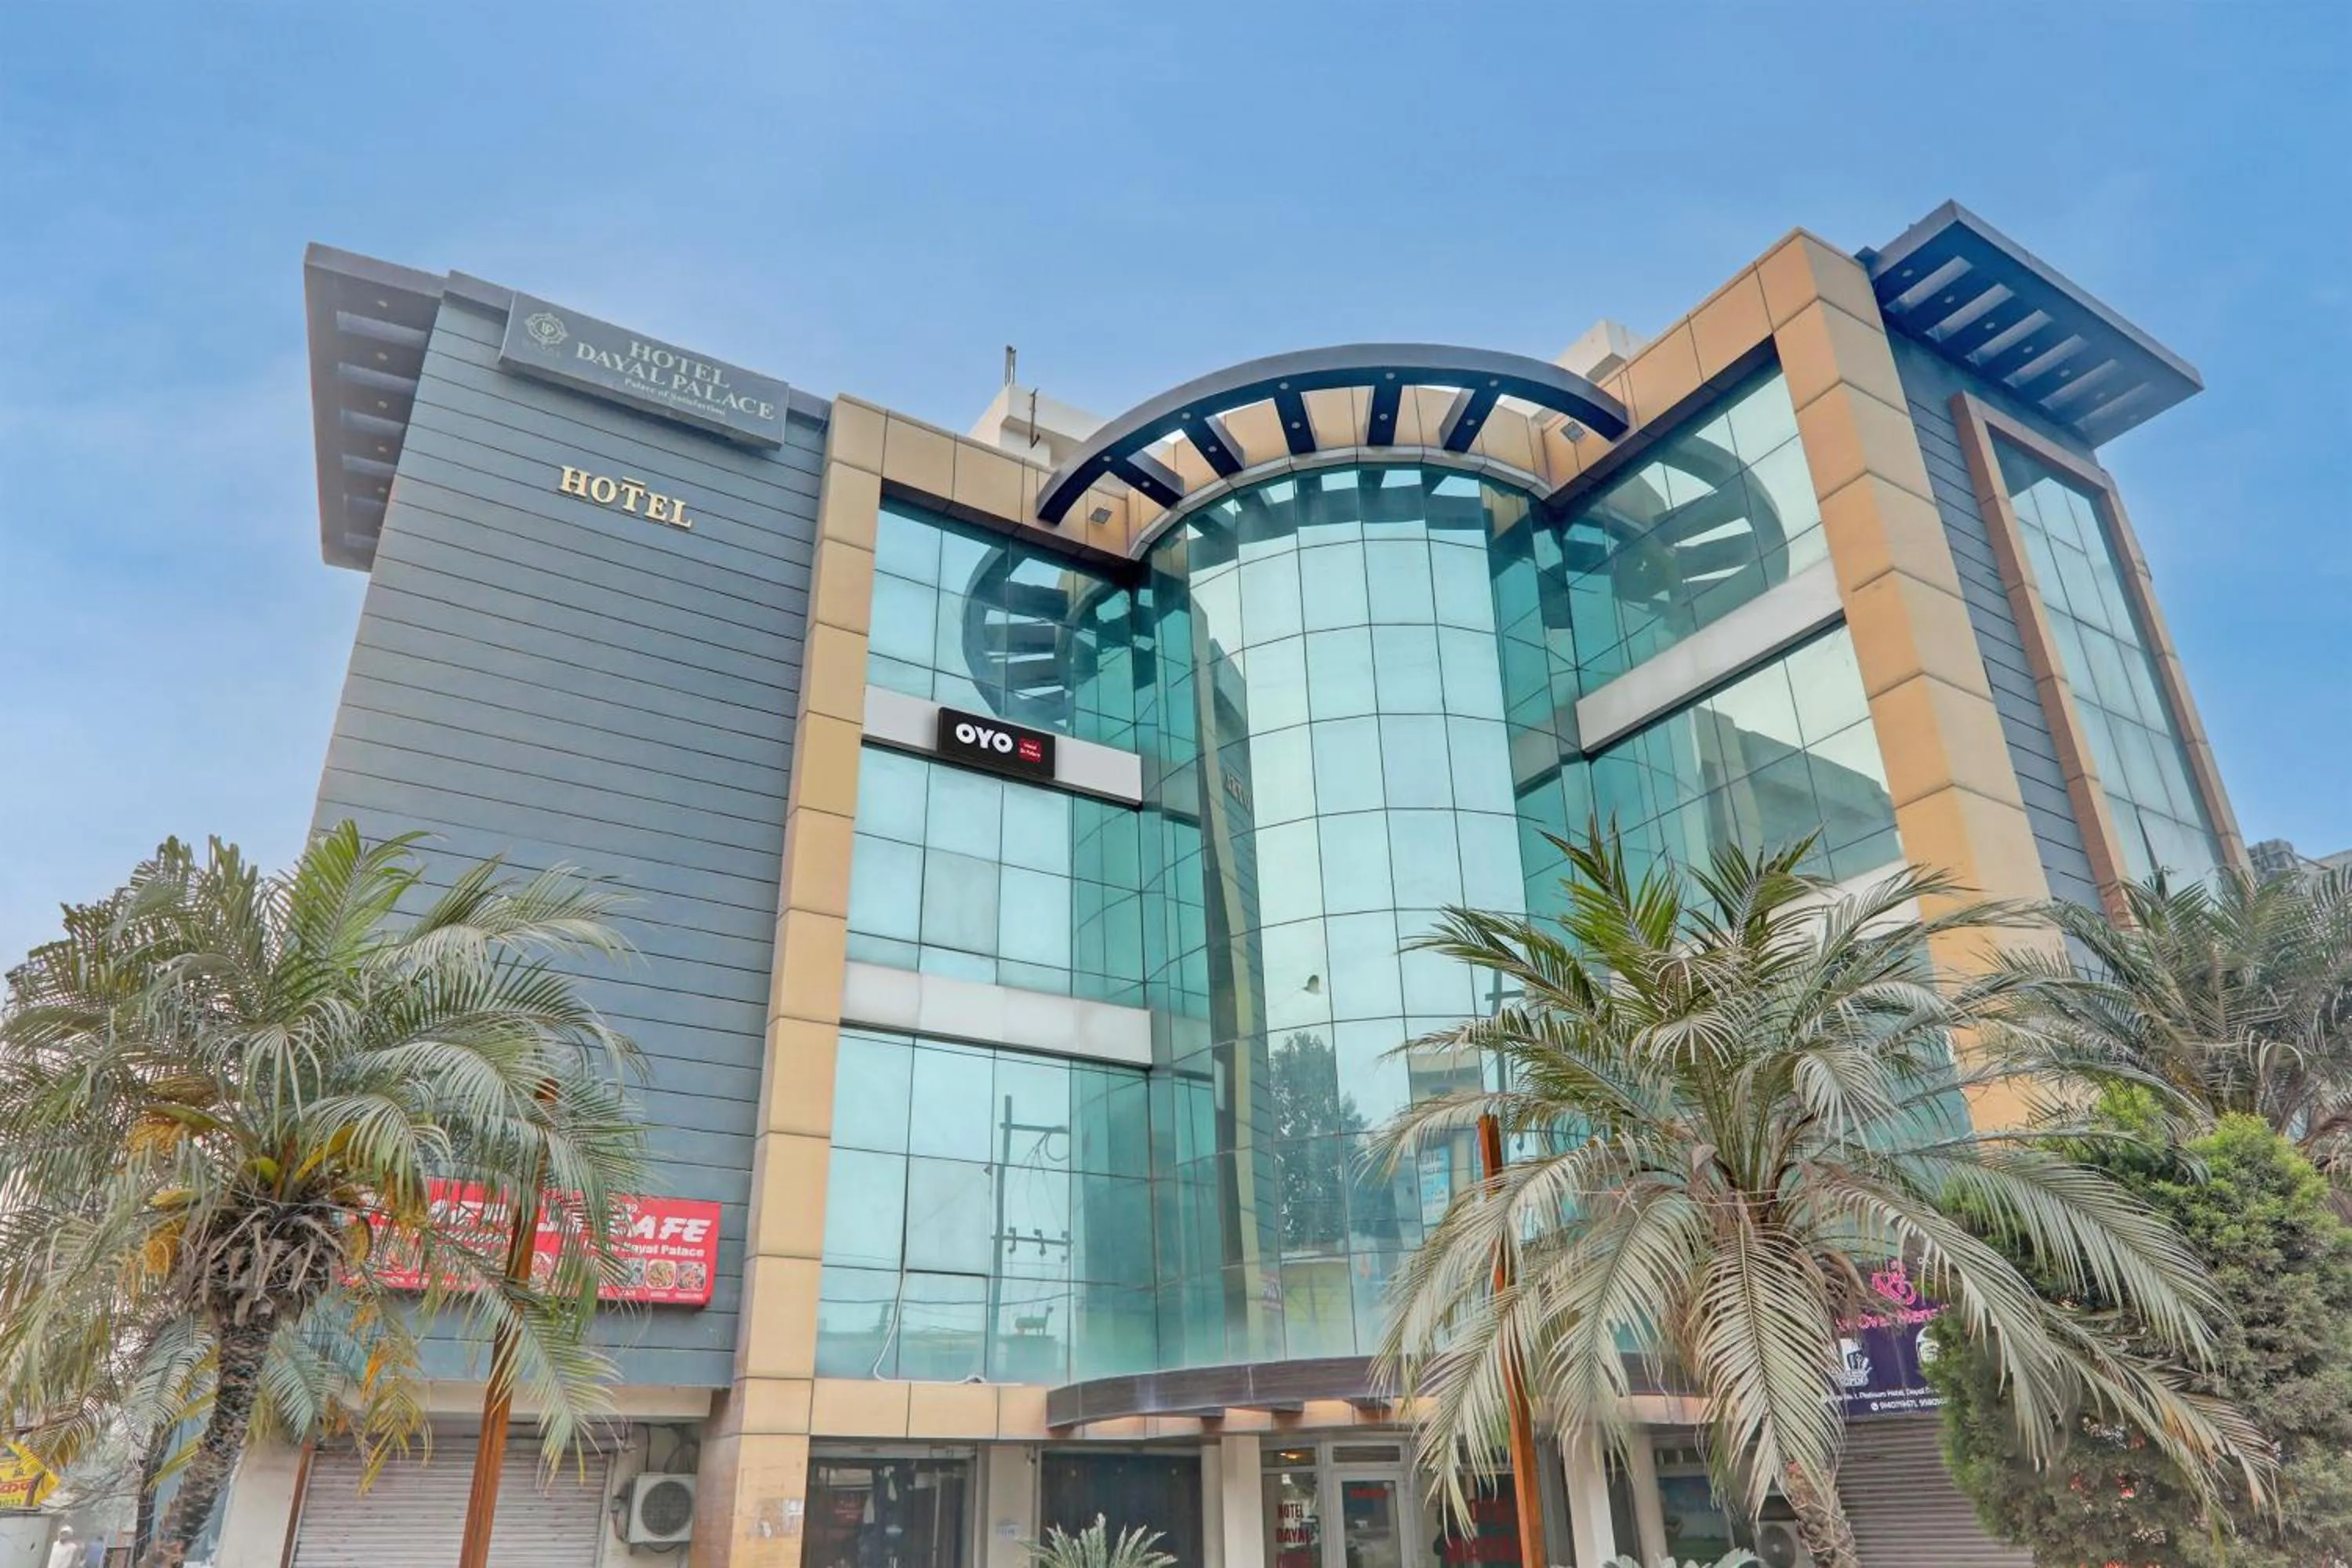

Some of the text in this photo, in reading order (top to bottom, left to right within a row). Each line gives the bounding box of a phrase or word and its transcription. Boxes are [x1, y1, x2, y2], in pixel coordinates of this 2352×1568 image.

[575, 342, 776, 420] DAYAL PALACE
[628, 339, 731, 389] HOTEL
[557, 465, 693, 529] HOTEL
[955, 723, 1014, 753] OYO
[661, 1244, 706, 1257] Palace
